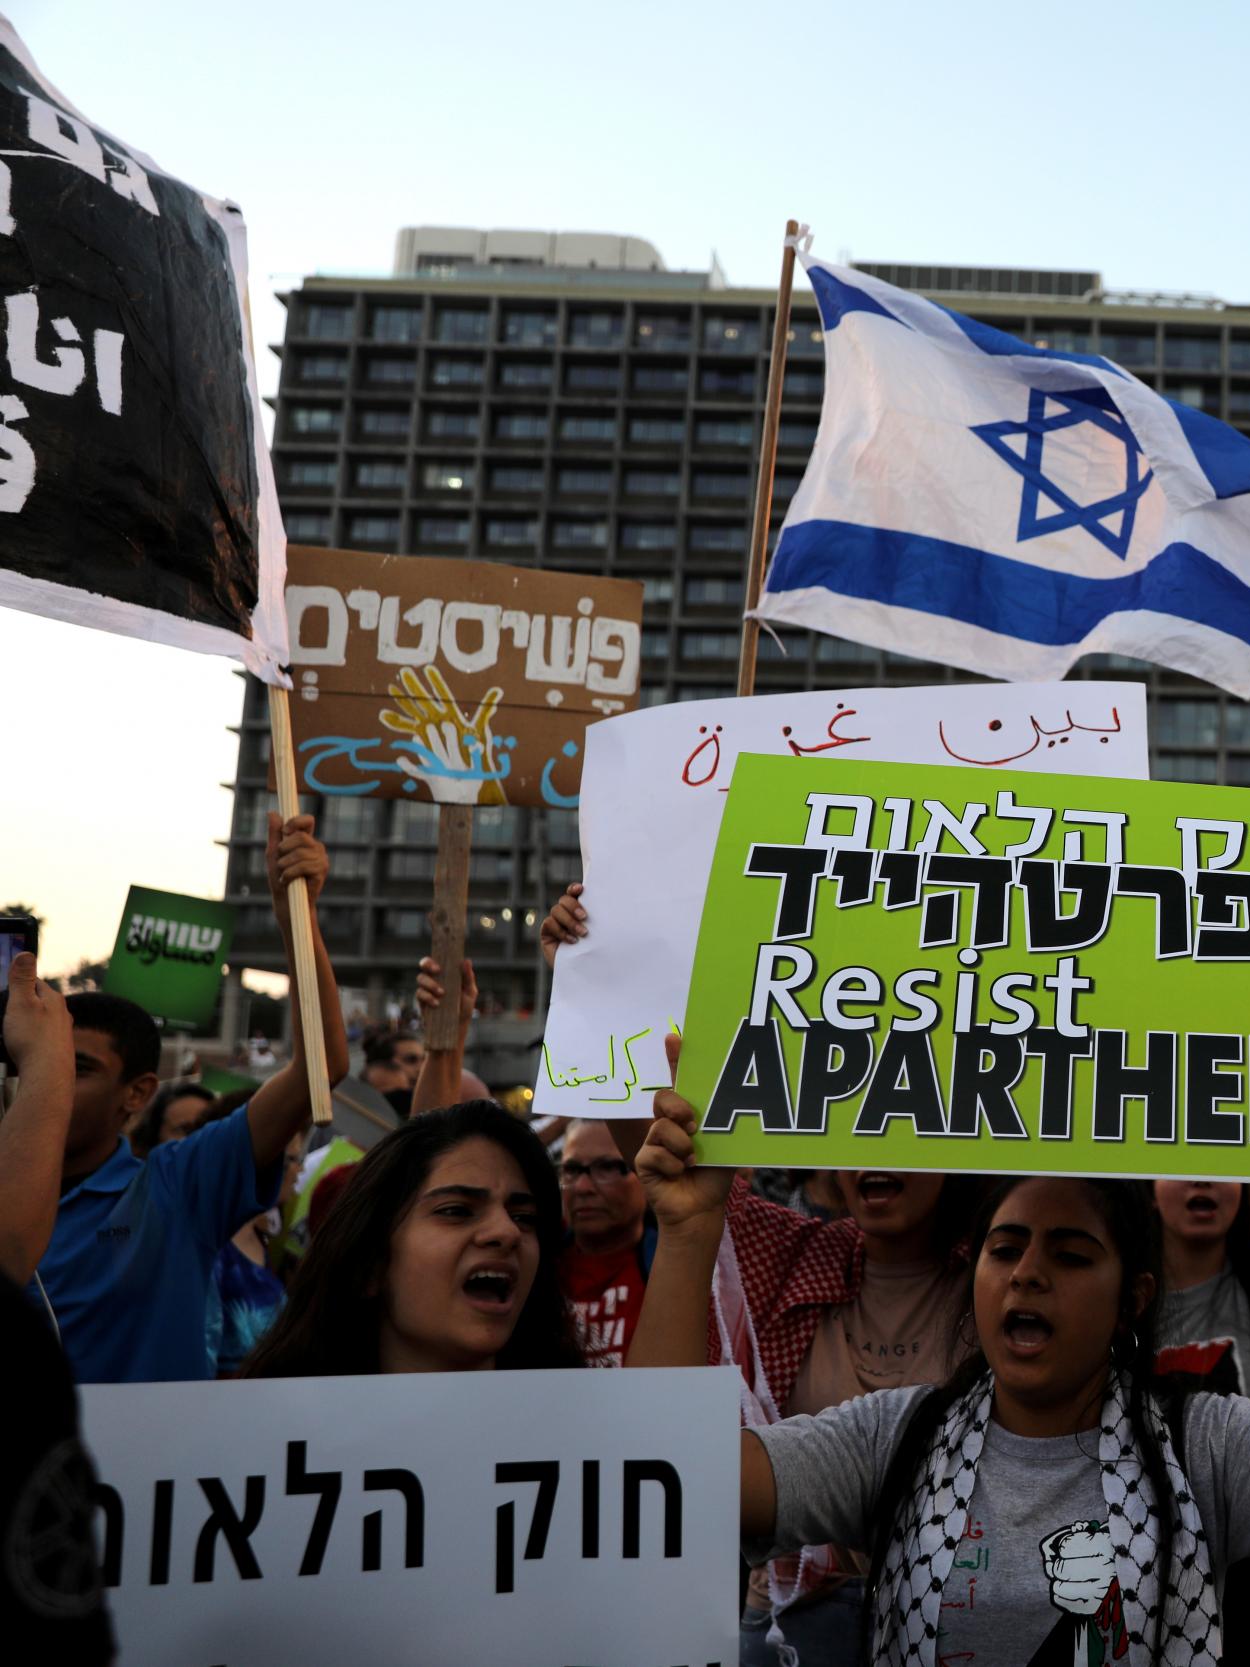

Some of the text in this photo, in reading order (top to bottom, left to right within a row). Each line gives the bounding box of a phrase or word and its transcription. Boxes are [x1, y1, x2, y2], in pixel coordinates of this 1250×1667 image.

[939, 706, 1122, 766] بين
[801, 789, 1128, 868] הלאום
[749, 942, 1094, 1039] Resist
[494, 1459, 683, 1594] חוק
